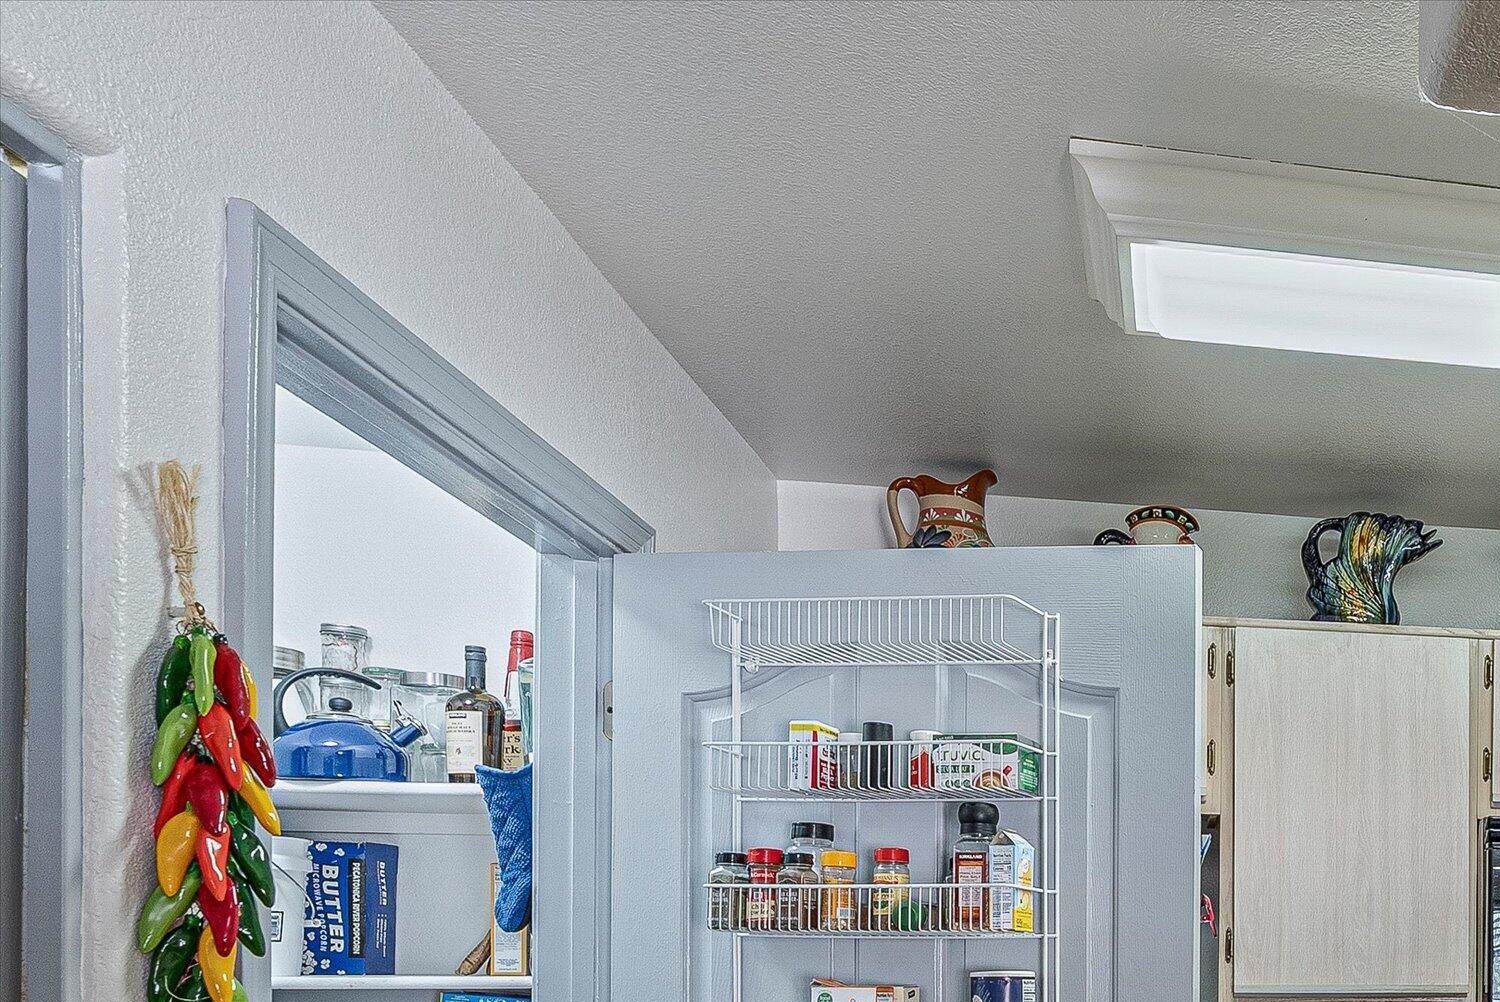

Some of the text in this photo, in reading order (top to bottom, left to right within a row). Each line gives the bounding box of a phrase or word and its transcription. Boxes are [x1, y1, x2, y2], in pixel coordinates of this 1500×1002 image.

[312, 862, 324, 911] MICROWAVE
[322, 864, 345, 953] BUTTER
[352, 924, 361, 955] POPCORN
